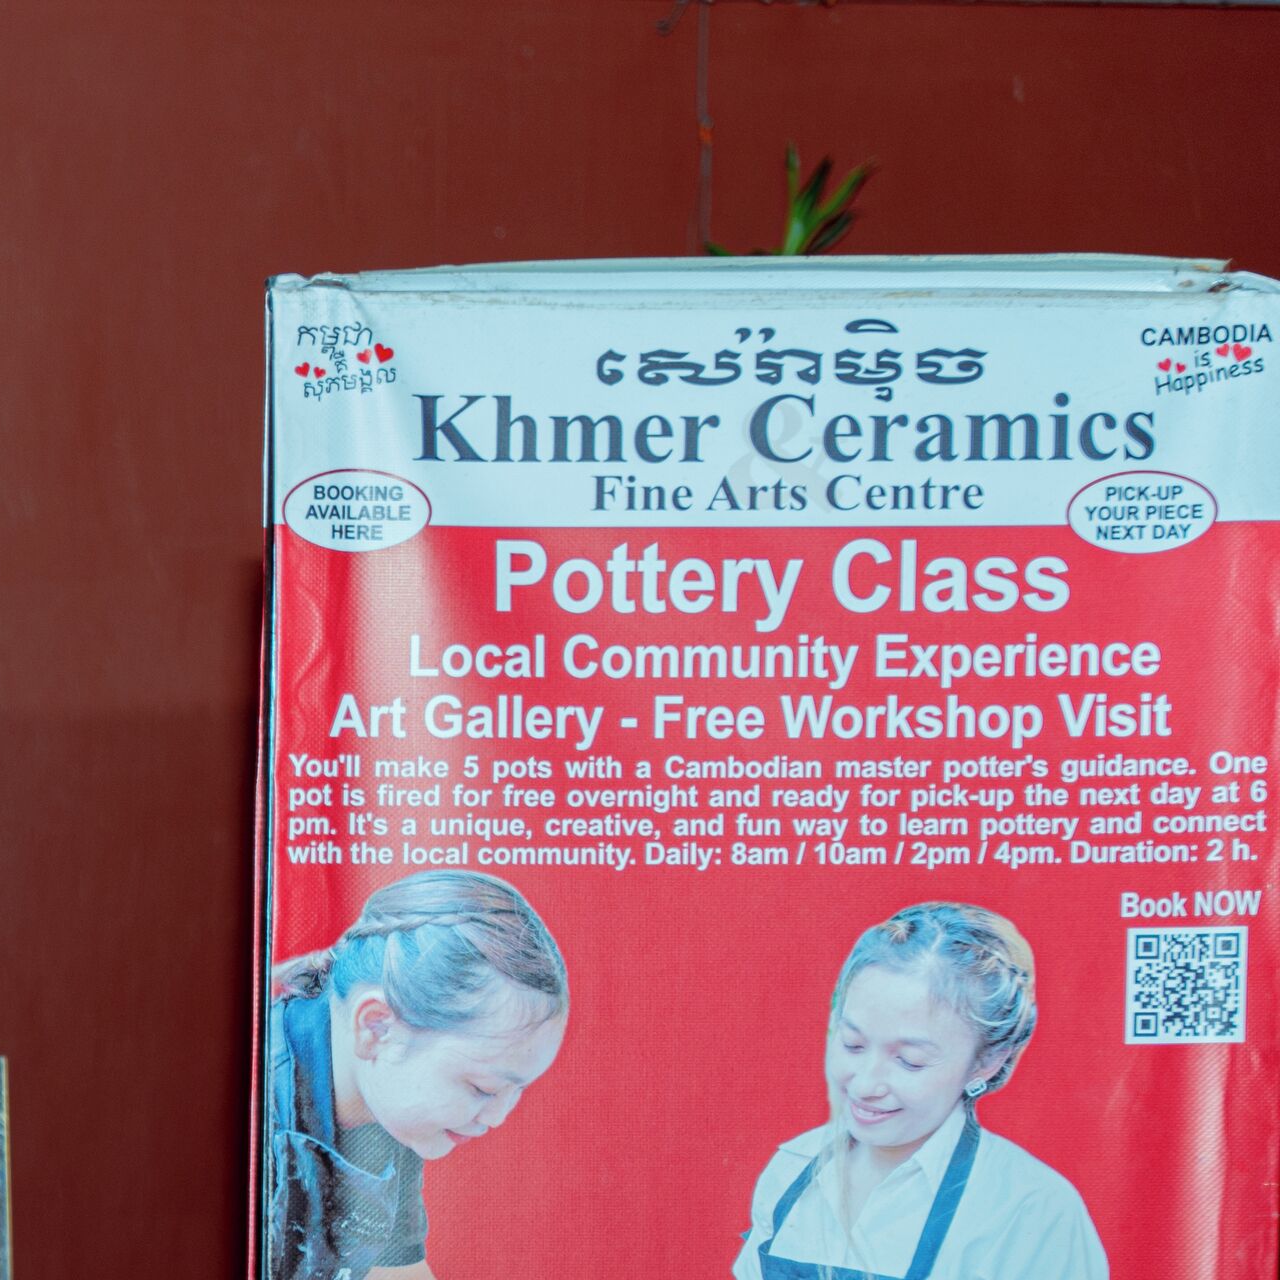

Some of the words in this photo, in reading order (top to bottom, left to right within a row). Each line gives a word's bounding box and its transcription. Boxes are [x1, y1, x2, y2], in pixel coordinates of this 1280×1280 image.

[1140, 322, 1273, 347] CAMBODIA
[1193, 350, 1211, 369] is
[1154, 356, 1265, 396] Happiness
[412, 393, 721, 464] Khmer
[749, 393, 1156, 463] Ceramics
[313, 485, 404, 502] BOOKING
[591, 475, 693, 512] Fine
[706, 475, 808, 512] Arts
[825, 473, 985, 512] Centre
[1105, 485, 1183, 502] PICK-UP
[305, 505, 411, 522] AVAILABLE
[1085, 505, 1142, 522] YOUR
[1145, 504, 1203, 521] PIECE
[331, 525, 383, 541] HERE
[1096, 525, 1148, 542] NEXT
[1150, 524, 1192, 541] DAY
[495, 539, 804, 632] Pottery
[831, 538, 1070, 613] Class
[409, 633, 545, 679] Local
[562, 633, 859, 689] Community
[875, 633, 1161, 688] Experience
[329, 693, 407, 739] Art
[424, 693, 604, 751] Gallery
[653, 694, 766, 739] Free
[780, 694, 1042, 749] Workshop
[1057, 693, 1172, 737] Visit
[289, 754, 361, 780] You'll
[374, 754, 448, 779] make
[462, 756, 480, 778] 5
[492, 755, 552, 783] pots
[565, 756, 622, 779] with
[635, 761, 652, 779] a
[664, 755, 822, 779] Cambodian
[835, 758, 931, 779] master
[943, 755, 1048, 783] potter's
[1060, 754, 1196, 783] guidance.
[1209, 750, 1268, 776] One
[287, 842, 342, 865] with
[351, 842, 393, 865] the
[403, 842, 470, 866] local
[477, 843, 636, 871] community.
[645, 842, 722, 871] Daily:
[731, 843, 788, 865] 8am
[813, 843, 887, 865] 10am
[910, 843, 970, 869] 2pm
[994, 842, 1063, 869] 4pm.
[1070, 840, 1198, 865] Duration:
[1205, 838, 1223, 862] 2
[1231, 838, 1259, 862] h.
[1119, 891, 1188, 919] Book
[1194, 890, 1262, 917] NOW
